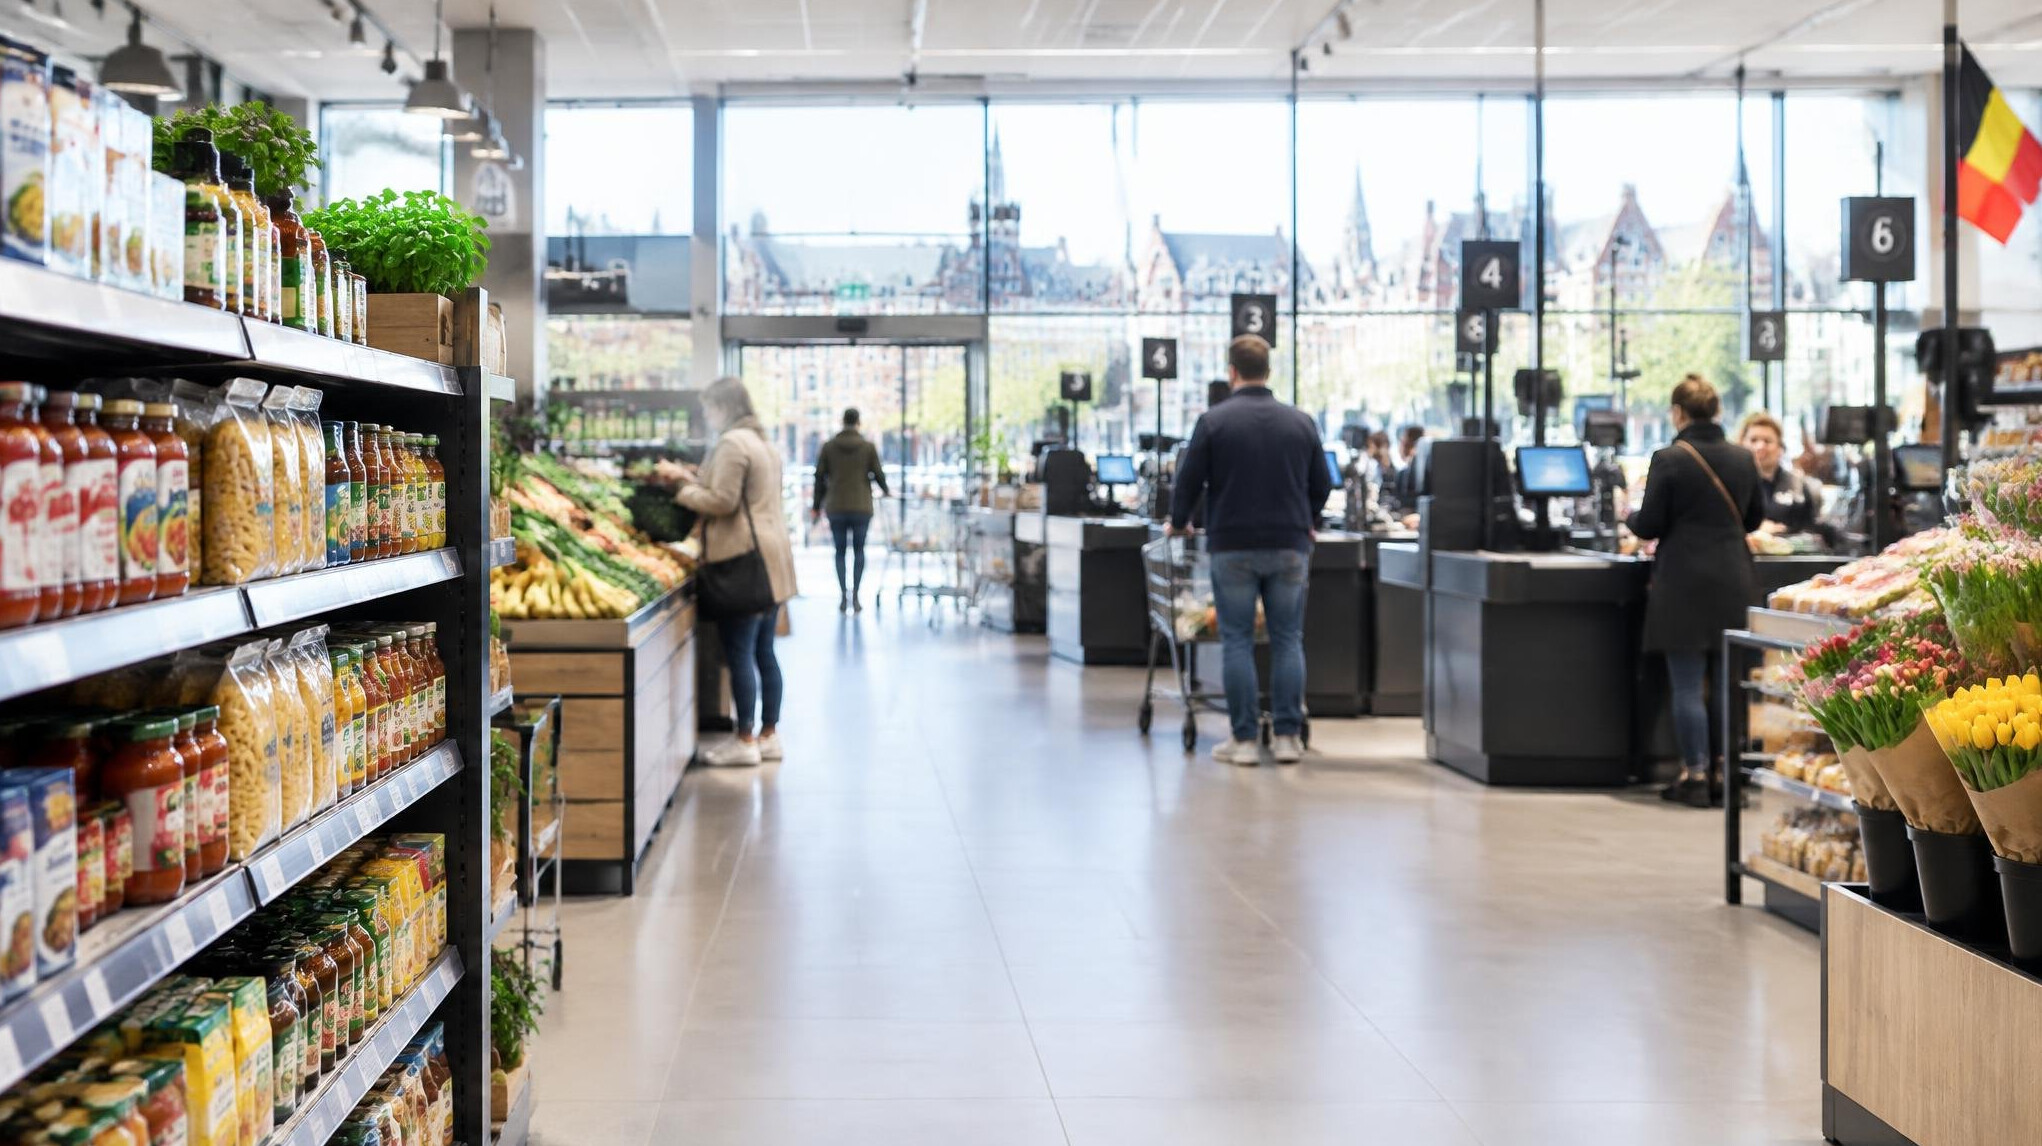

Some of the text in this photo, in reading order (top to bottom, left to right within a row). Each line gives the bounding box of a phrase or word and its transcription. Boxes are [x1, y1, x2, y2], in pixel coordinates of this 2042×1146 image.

[1871, 216, 1895, 254] 6
[1480, 257, 1503, 289] 4
[1245, 305, 1264, 333] 3
